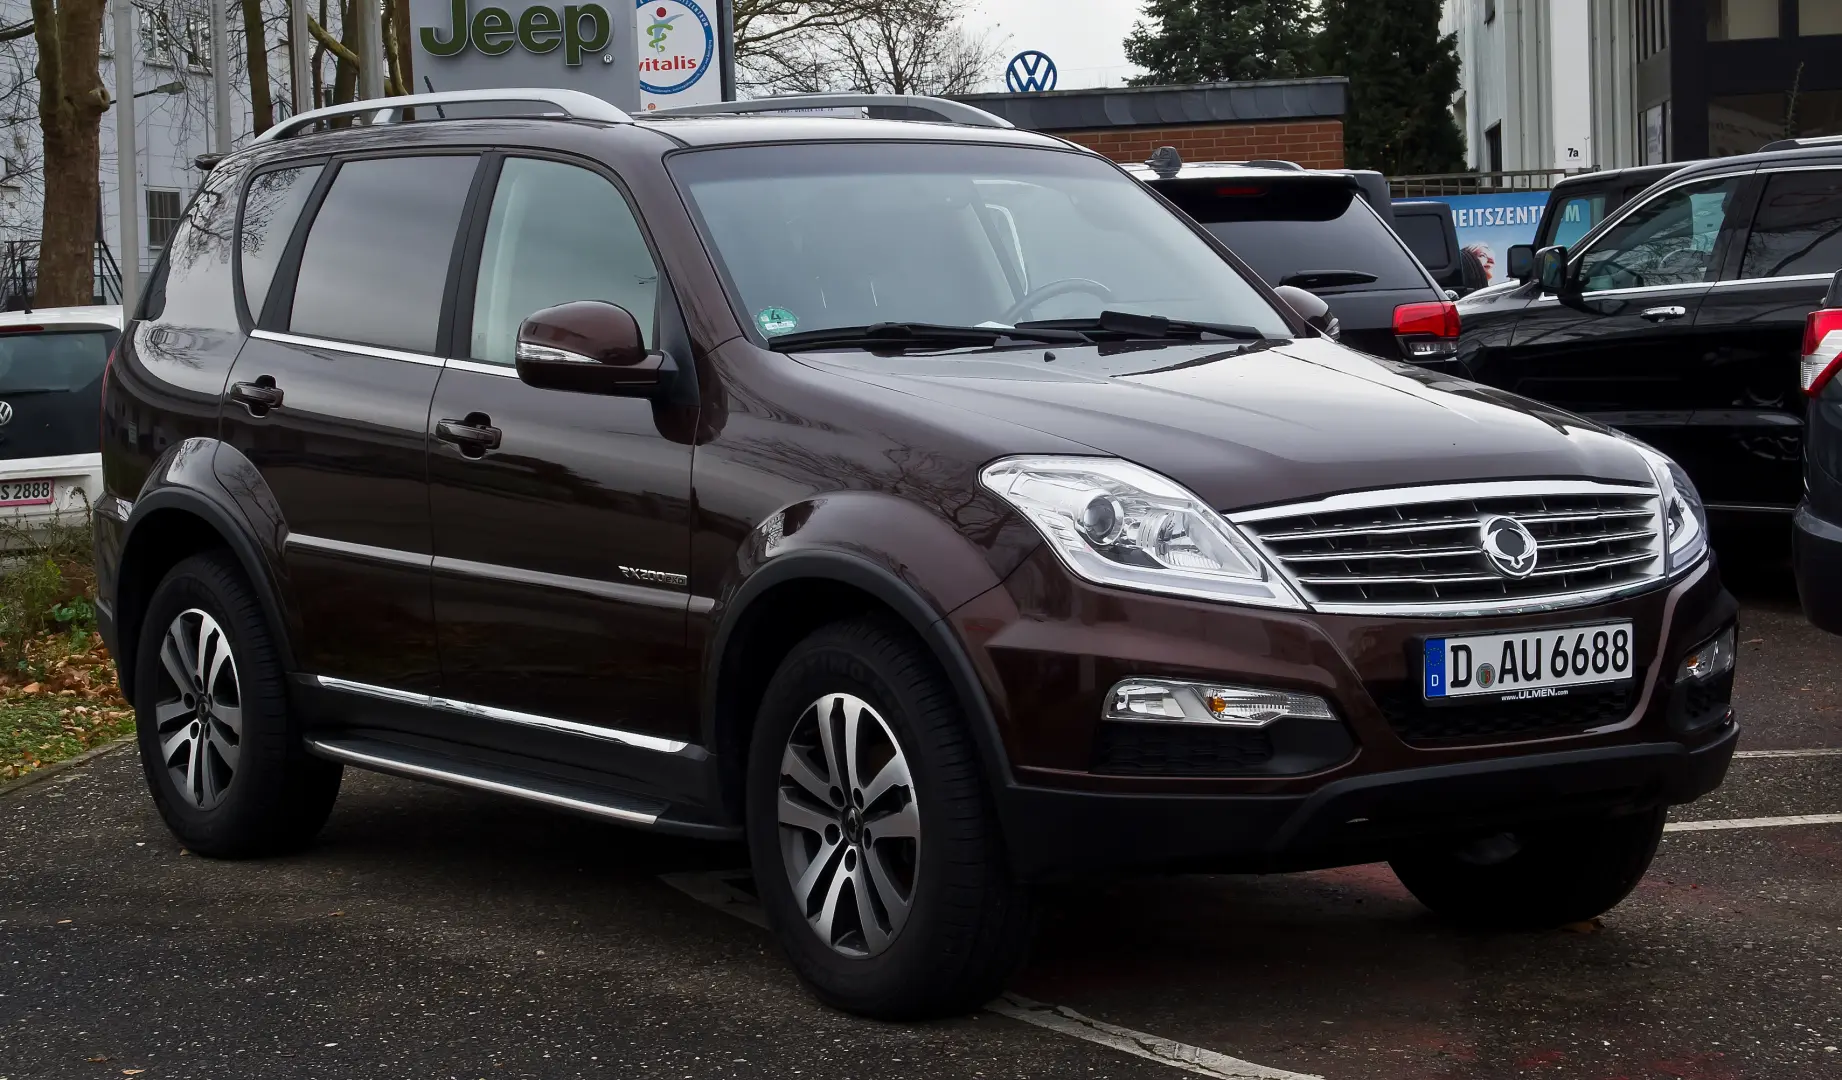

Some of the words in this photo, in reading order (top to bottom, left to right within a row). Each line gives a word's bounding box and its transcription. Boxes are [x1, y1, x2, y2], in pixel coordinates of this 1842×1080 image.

[419, 0, 613, 66] Jeep
[1567, 147, 1579, 158] 7a
[13, 482, 50, 499] 2888
[1450, 644, 1472, 688] D
[1498, 637, 1542, 684] AU
[1550, 629, 1629, 678] 6688
[1431, 674, 1439, 687] D
[1501, 688, 1569, 701] www.ULMEN.com
